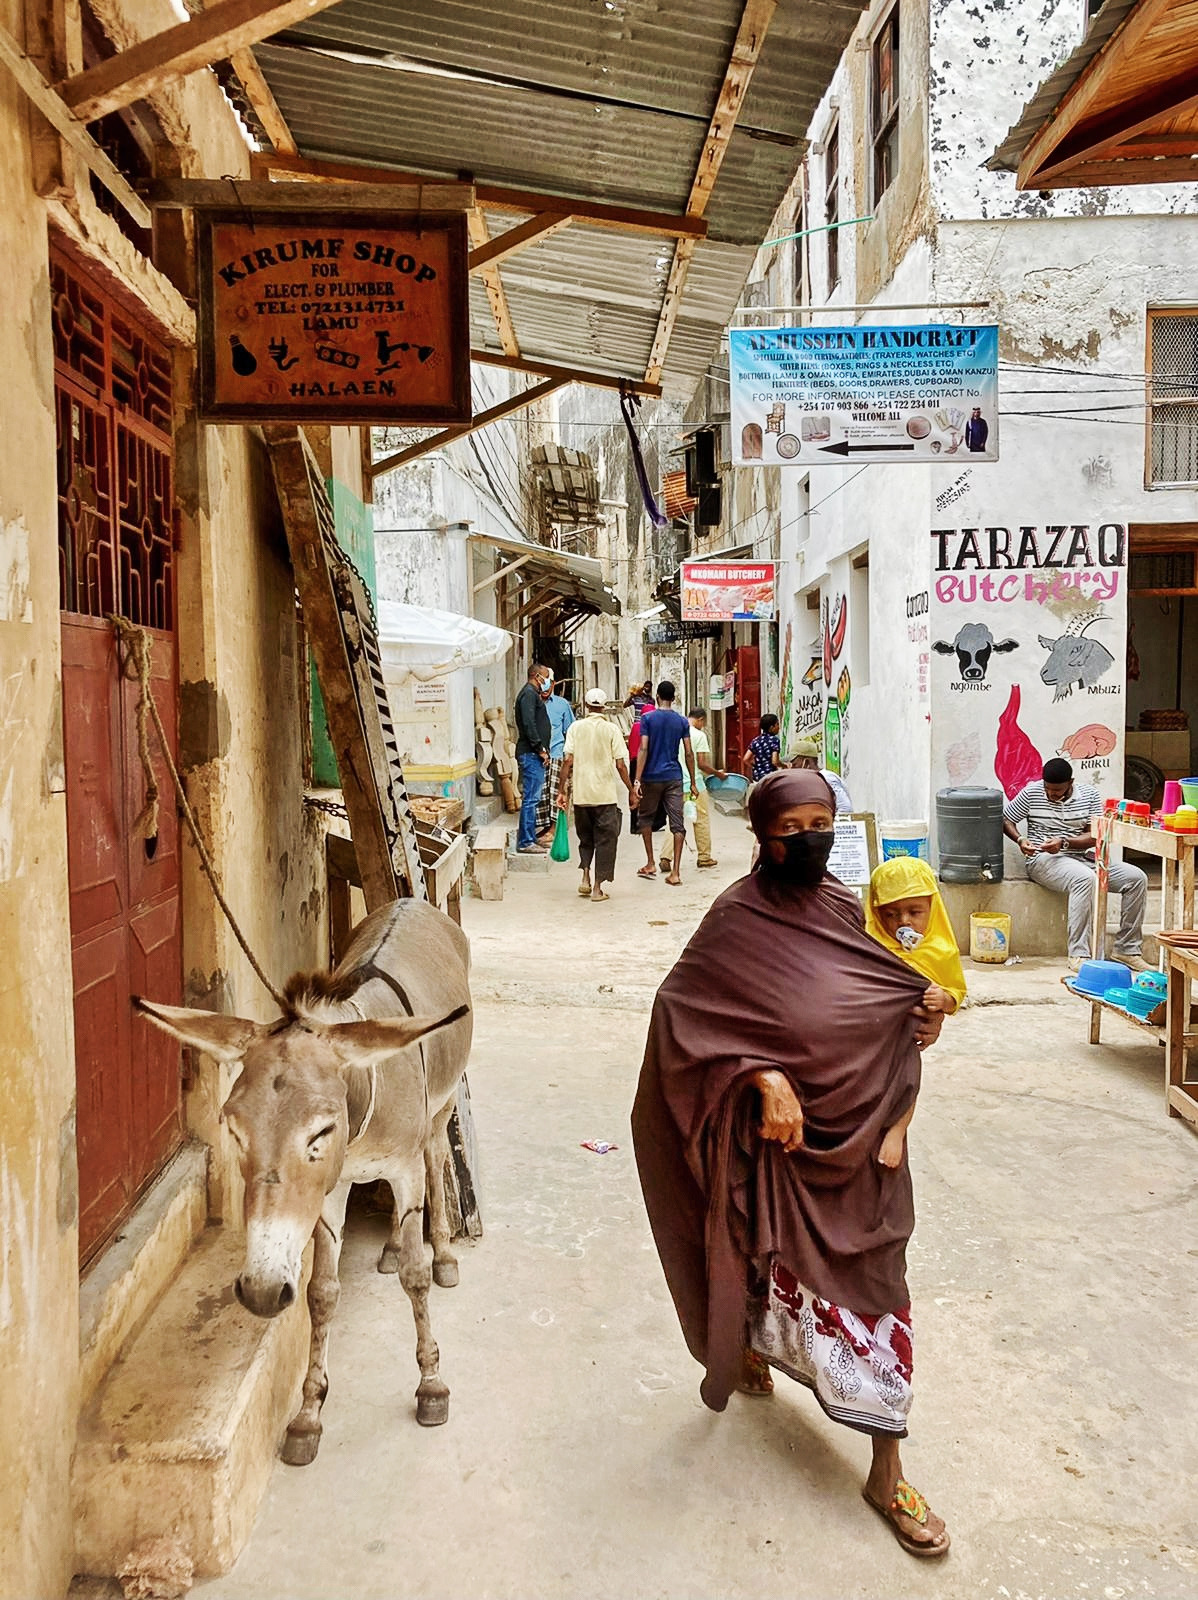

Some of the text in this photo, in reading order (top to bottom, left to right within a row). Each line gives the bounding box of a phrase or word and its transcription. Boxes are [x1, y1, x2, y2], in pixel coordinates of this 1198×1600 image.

[353, 241, 436, 283] SHOP
[311, 263, 339, 278] FOR
[264, 283, 312, 299] ELECT.
[329, 281, 395, 297] PLUMBER
[254, 300, 406, 315] TEL: 0721314731
[302, 316, 359, 331] LAMU
[746, 329, 980, 351] AL-HUSSEIN HANDCRAFT
[916, 349, 955, 359] WATCHES
[957, 349, 976, 358] ETC)
[856, 360, 881, 370] RINGS
[883, 360, 889, 369] &
[891, 359, 934, 369] NECKLESS
[936, 359, 954, 369] ETC)
[800, 371, 806, 379] &
[808, 370, 831, 379] OMAN
[931, 368, 938, 377] &
[939, 368, 963, 377] OMAN
[965, 366, 995, 377] KANZU)
[289, 380, 397, 397] HALAEN
[914, 377, 962, 387] CUPBOARD)
[752, 388, 982, 402] FOR MORE INFORMATION PLEASE CONTACT No.
[797, 402, 818, 411] +254
[821, 402, 834, 410] 707
[837, 401, 851, 410] 903
[854, 401, 869, 410] 866
[894, 400, 909, 409] 722
[911, 399, 925, 408] 234
[851, 411, 901, 421] WELCOME ALL
[930, 524, 1126, 571] TARAZAQ
[690, 569, 766, 580] MKOMANI BUTCHERY
[950, 682, 992, 693] Ngombe
[1080, 758, 1111, 770] KUKU
